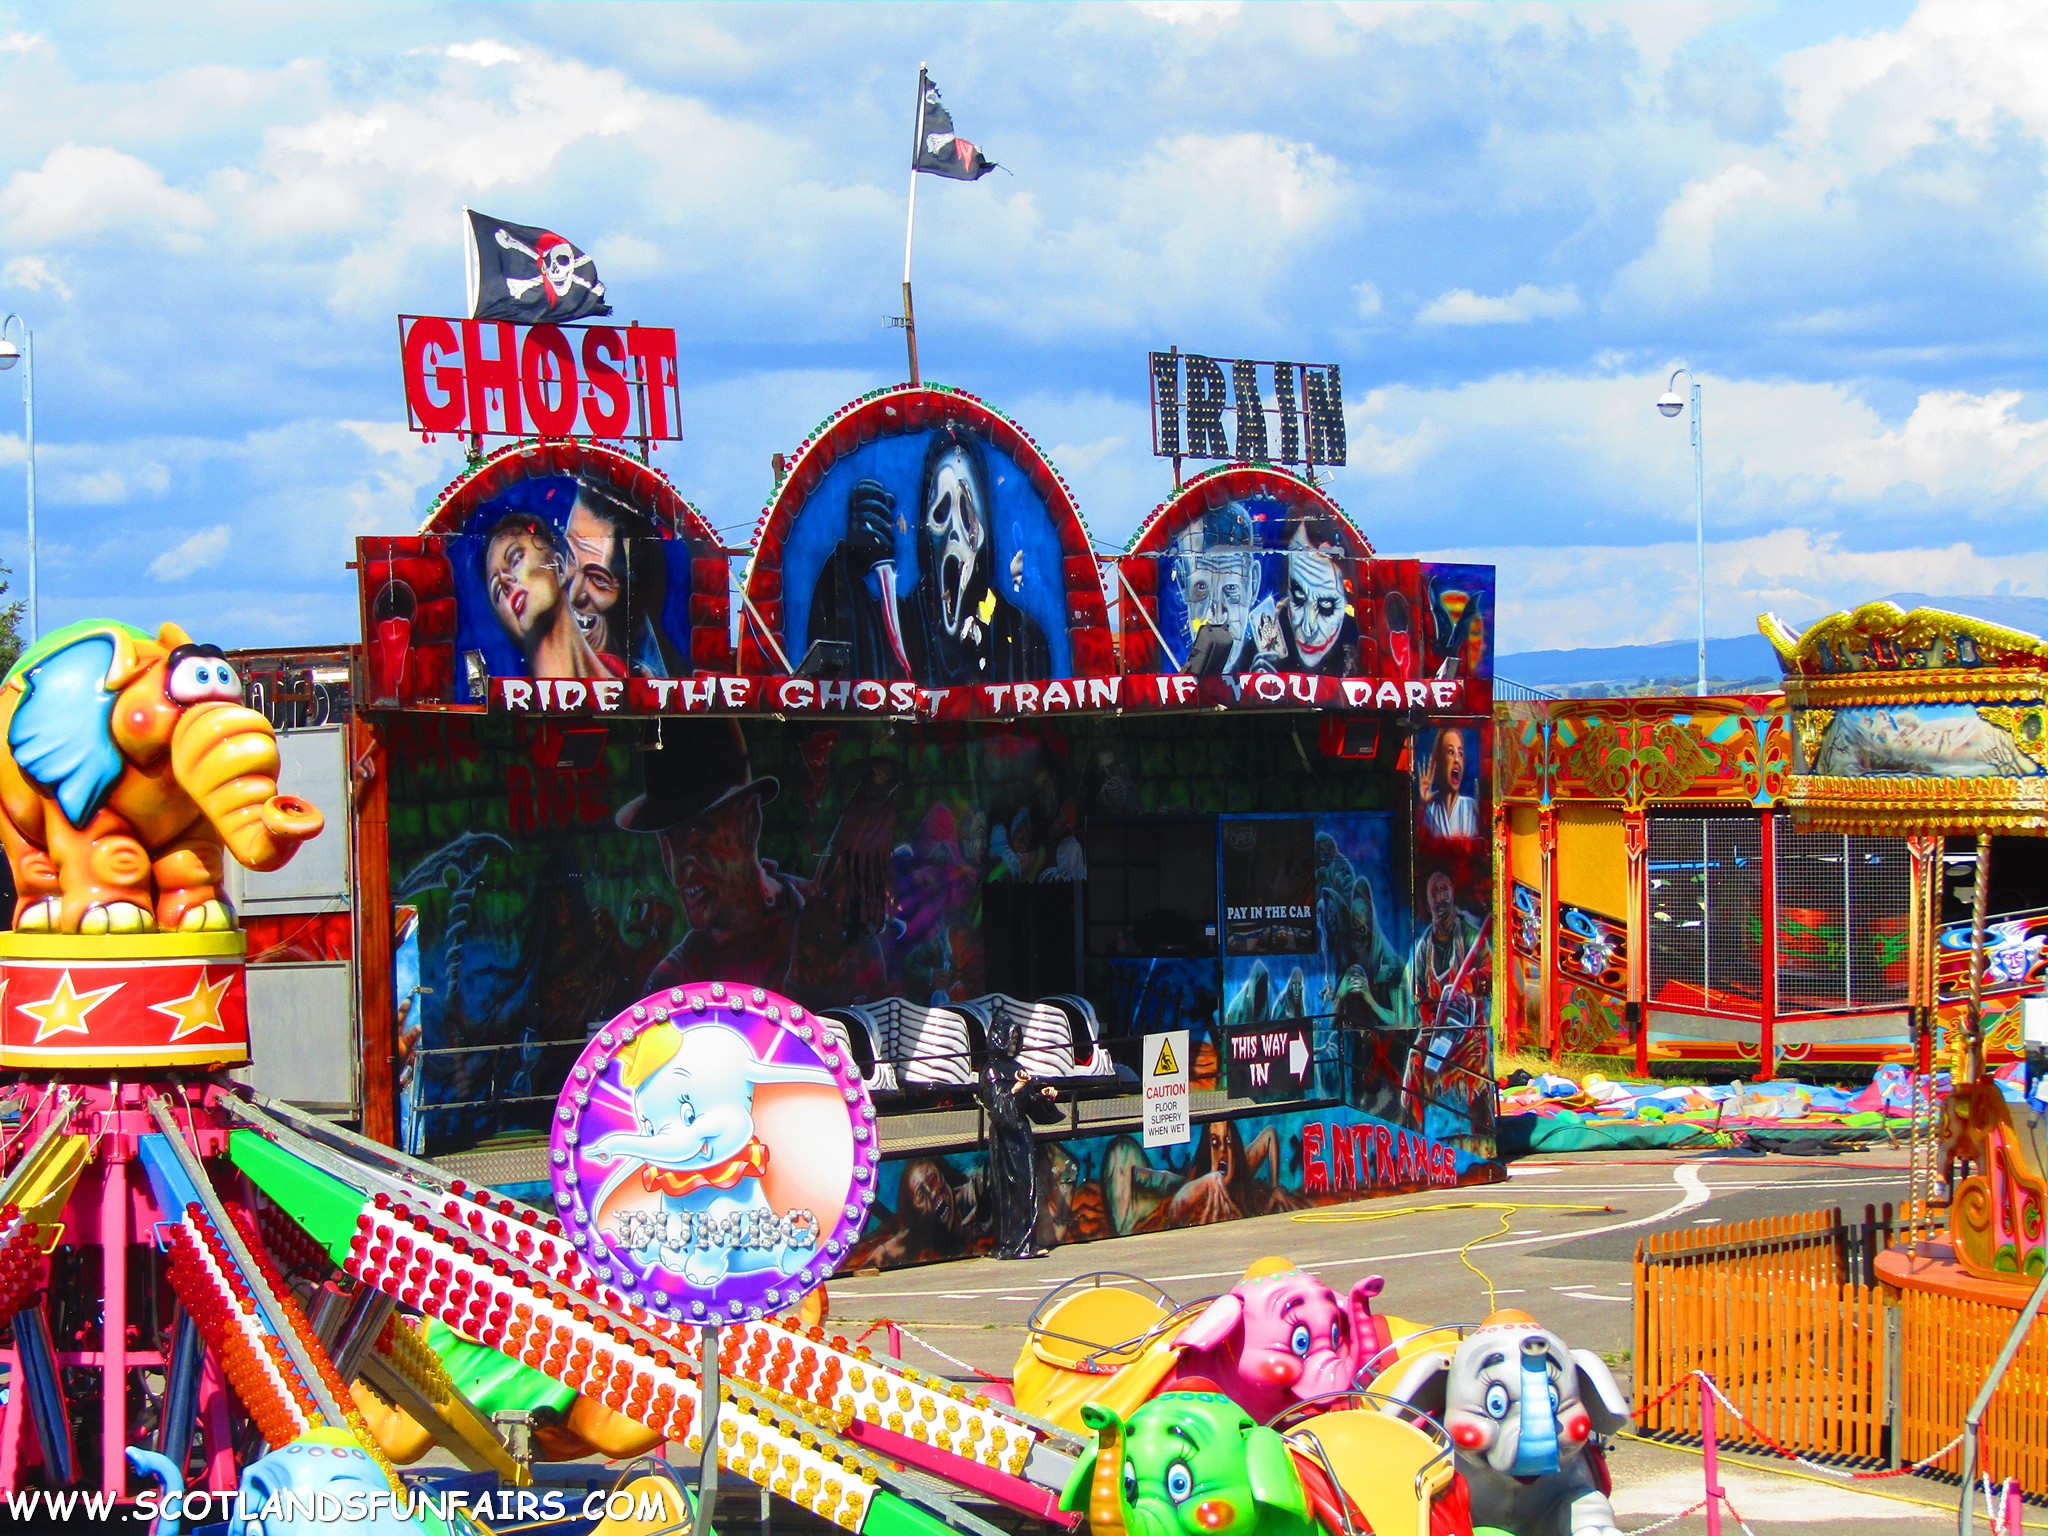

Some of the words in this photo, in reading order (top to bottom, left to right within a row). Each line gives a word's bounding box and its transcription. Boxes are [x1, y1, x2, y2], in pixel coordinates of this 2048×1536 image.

[405, 316, 676, 440] GHOST
[1152, 351, 1347, 467] TRAIN
[504, 679, 622, 712] RIDE
[647, 676, 751, 711] THE
[779, 679, 949, 717] GHOST
[986, 676, 1123, 715] TRAIN
[1157, 676, 1199, 703] IF
[1221, 673, 1319, 704] YOU
[1341, 679, 1458, 709] DARE
[1226, 906, 1248, 920] PAY
[1250, 906, 1263, 919] IN
[1265, 905, 1287, 919] THE
[1289, 905, 1312, 919] CAR
[1231, 1034, 1258, 1060] THIS
[1261, 1031, 1289, 1058] WAY
[1249, 1062, 1270, 1087] IN
[1146, 1082, 1187, 1100] CAUTION
[1150, 1112, 1182, 1125] SLIPPERY
[1155, 1101, 1178, 1112] FLOOR
[1147, 1125, 1169, 1137] WHEN
[1170, 1123, 1186, 1134] WET
[1301, 1121, 1458, 1194] ENTRANCE
[611, 1206, 820, 1251] DUMBO
